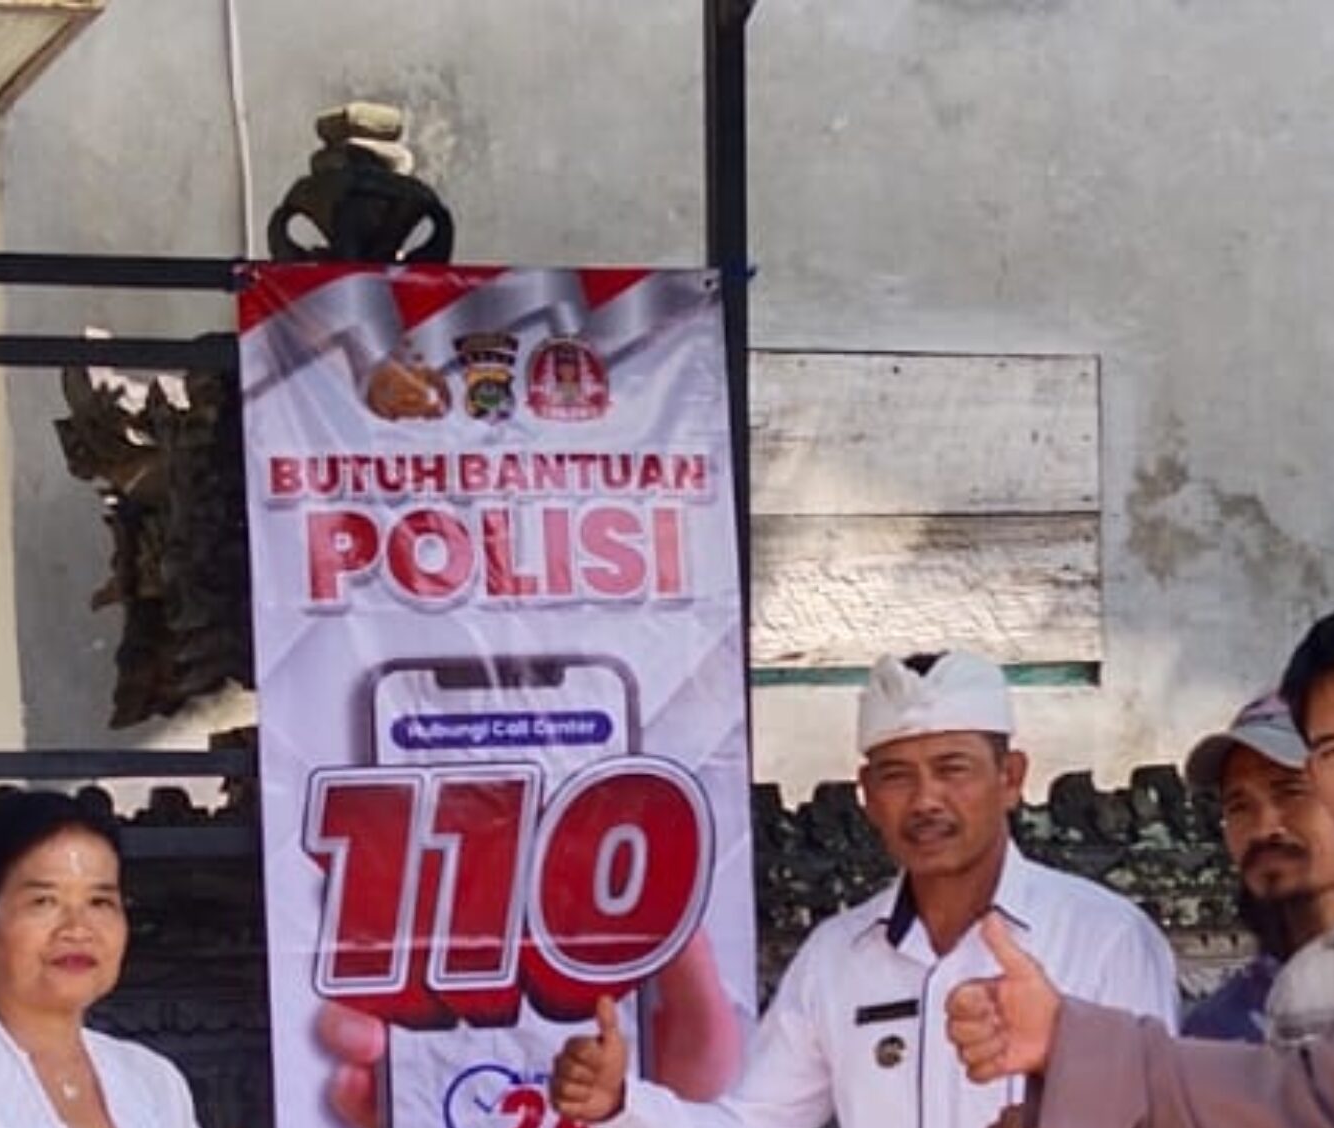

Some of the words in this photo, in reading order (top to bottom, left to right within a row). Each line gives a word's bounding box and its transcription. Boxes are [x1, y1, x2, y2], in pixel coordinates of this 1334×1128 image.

[269, 455, 445, 494] BUTUH
[458, 452, 707, 492] BANTUAN
[307, 507, 682, 602] POLISI
[407, 720, 487, 744] Hubungi
[492, 719, 529, 737] Call
[533, 717, 597, 736] Center
[303, 756, 715, 1000] 110
